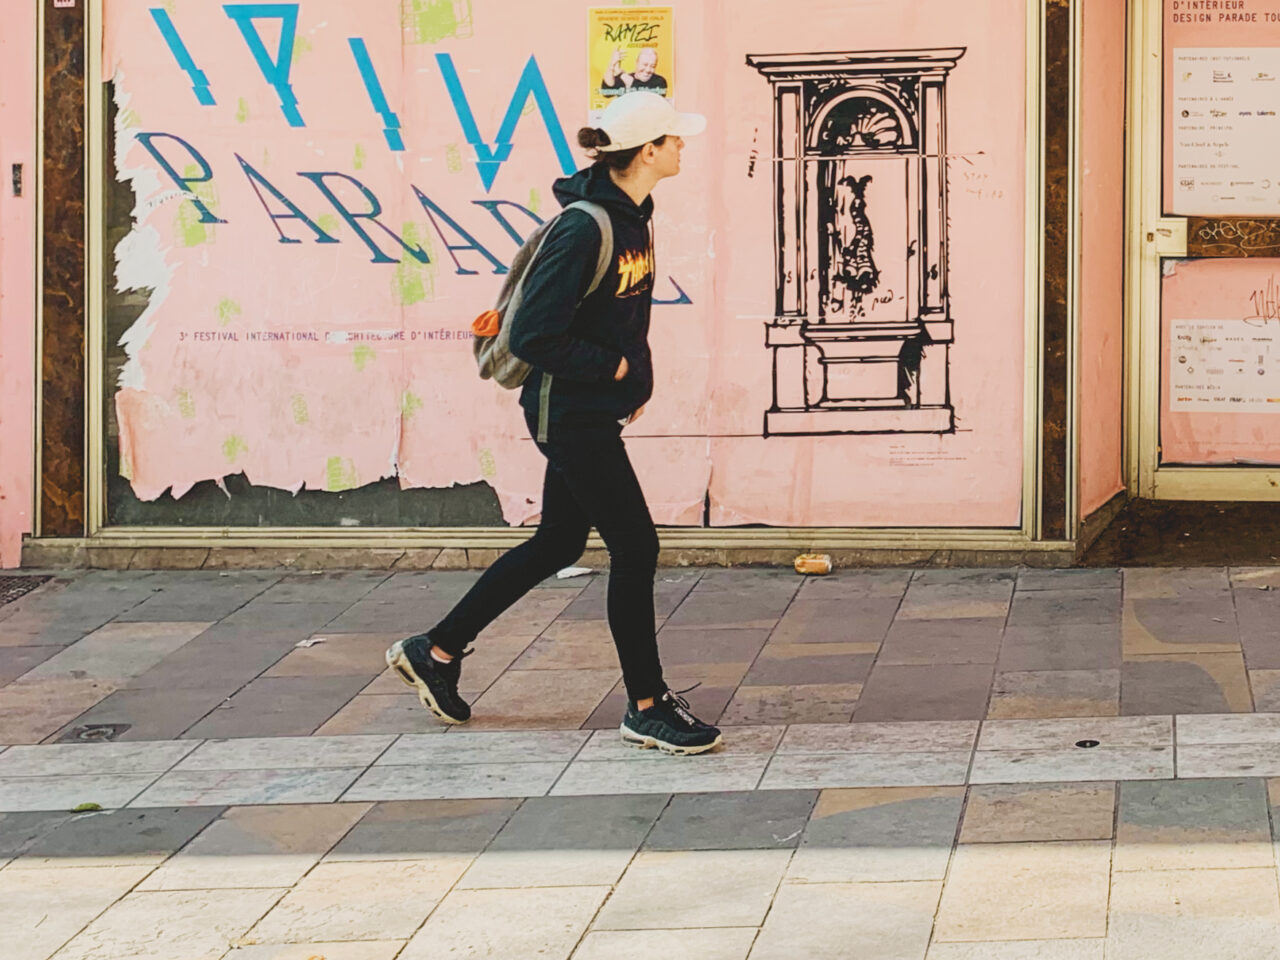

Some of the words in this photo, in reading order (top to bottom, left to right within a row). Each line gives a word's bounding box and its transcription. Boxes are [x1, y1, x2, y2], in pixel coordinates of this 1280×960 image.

[1173, 13, 1212, 23] DESIGN
[1218, 13, 1257, 22] PARADE
[602, 22, 661, 43] RAMZI
[193, 331, 239, 341] FESTIVAL
[245, 331, 319, 341] INTERNATIONAL
